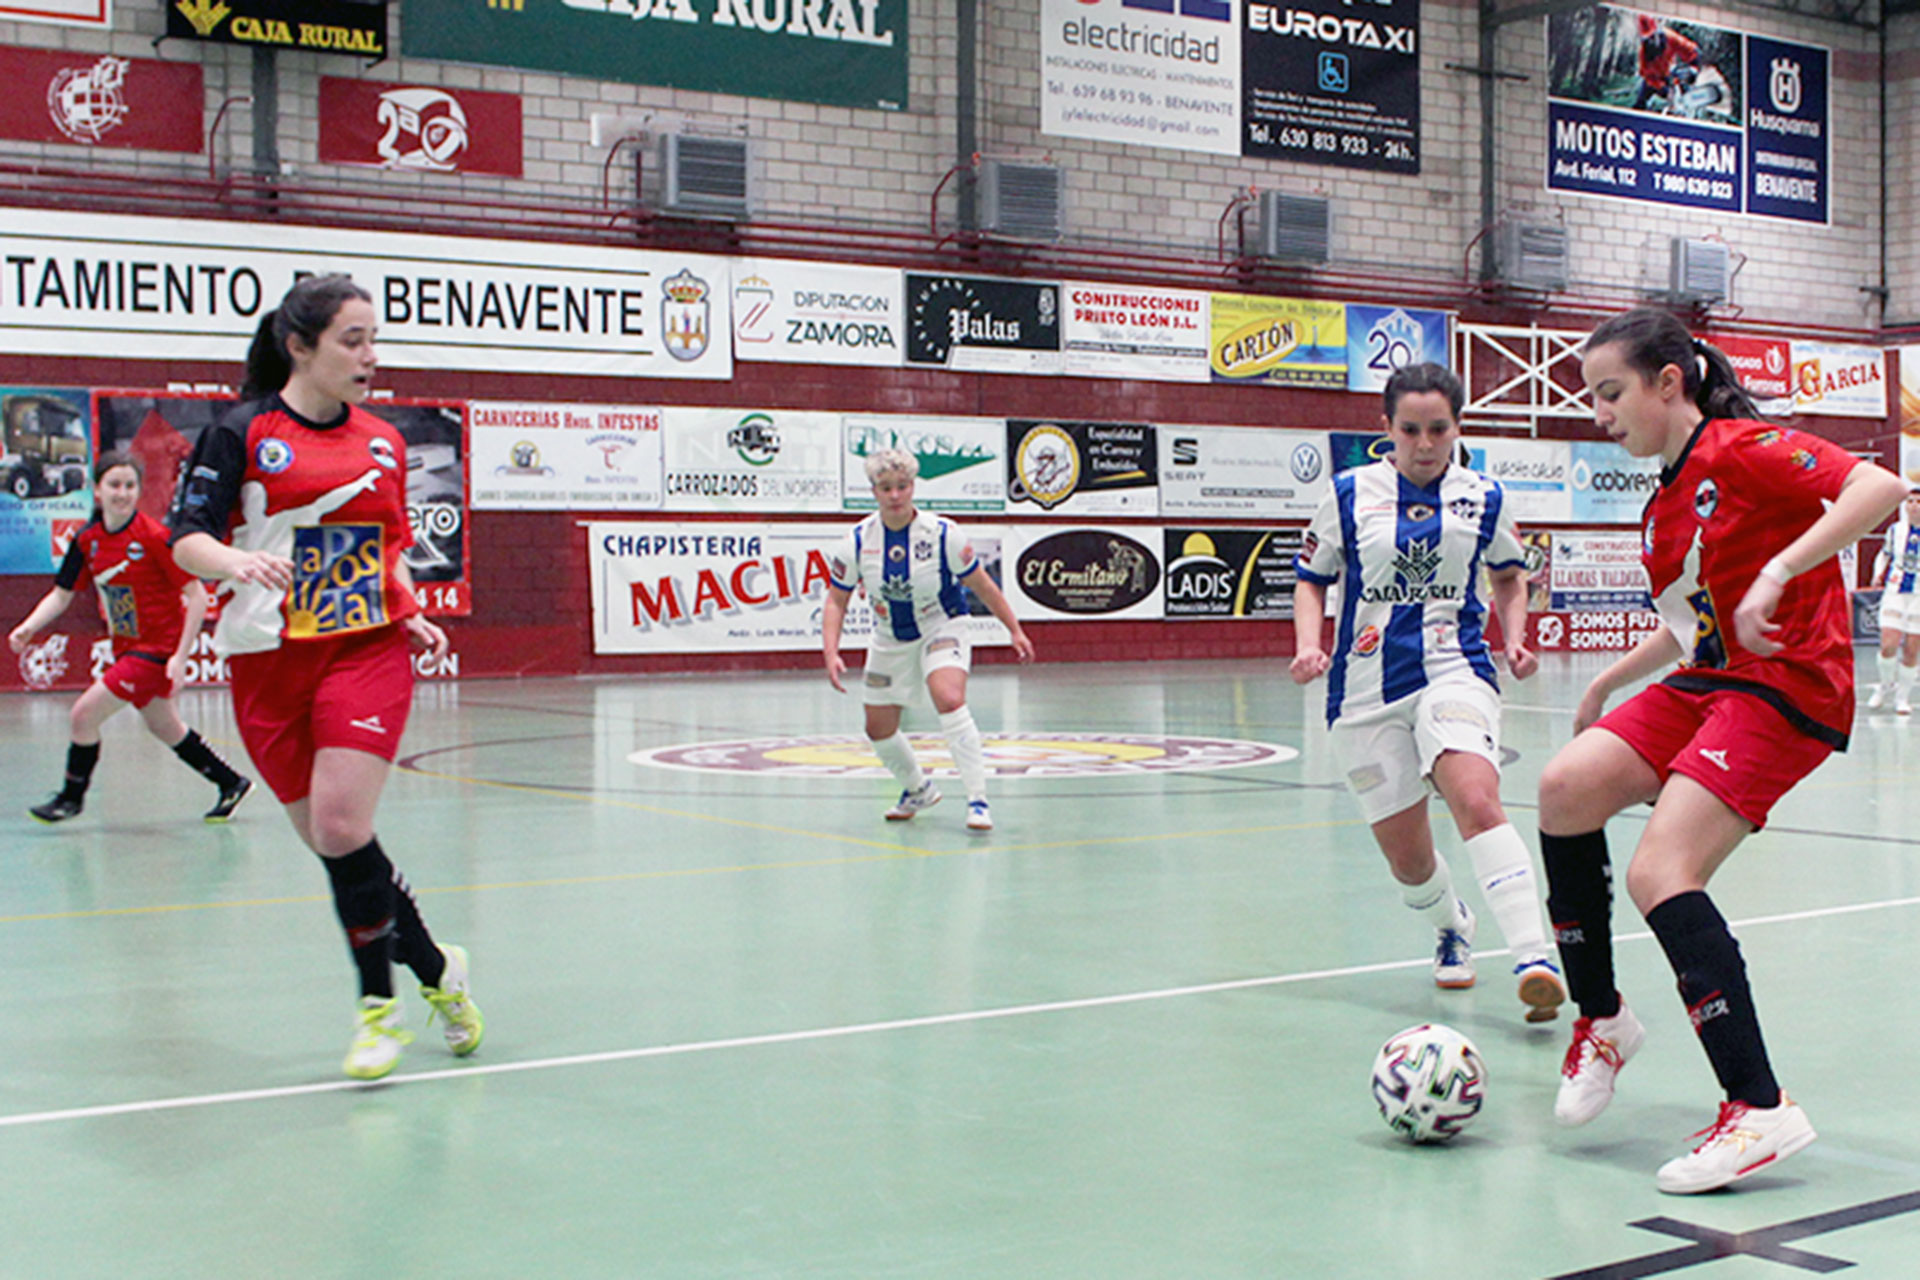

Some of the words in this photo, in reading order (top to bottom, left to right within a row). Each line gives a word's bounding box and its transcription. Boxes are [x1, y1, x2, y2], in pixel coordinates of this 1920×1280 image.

[230, 16, 294, 44] CAJA
[298, 23, 384, 53] RURAL
[713, 0, 893, 47] RURAL
[1249, 4, 1415, 53] EUROTAXI
[1063, 16, 1220, 65] electricidad
[1073, 84, 1097, 99] 639
[1100, 88, 1117, 101] 68
[1119, 91, 1136, 104] 93
[1138, 92, 1154, 105] 96
[1165, 96, 1234, 116] BENAVENTE
[1249, 124, 1276, 145] Tel.
[1280, 127, 1309, 149] 630
[1312, 131, 1337, 152] 813
[1341, 134, 1368, 156] 933
[1556, 120, 1637, 161] MOTOS
[1641, 132, 1736, 175] ESTEBAN
[1617, 167, 1638, 187] 112
[1756, 172, 1817, 204] BENAVENTE
[384, 276, 643, 336] BENAVENTE
[1072, 291, 1200, 312] CONSTRUCCIONES
[948, 307, 1021, 344] Palas
[1074, 309, 1128, 326] PRIETO
[786, 320, 897, 349] ZAMORA
[1367, 328, 1413, 371] 20
[1796, 360, 1881, 397] GARCIA
[598, 412, 660, 431] INFESTAS
[667, 473, 759, 497] CARROZADOS
[1164, 471, 1206, 481] SEAT
[603, 535, 762, 557] CHAPISTERIA
[1024, 559, 1046, 587] El
[1167, 572, 1232, 599] LADIS
[434, 586, 459, 609] 14
[1570, 612, 1626, 630] SOMOS
[1570, 631, 1626, 649] SOMOS
